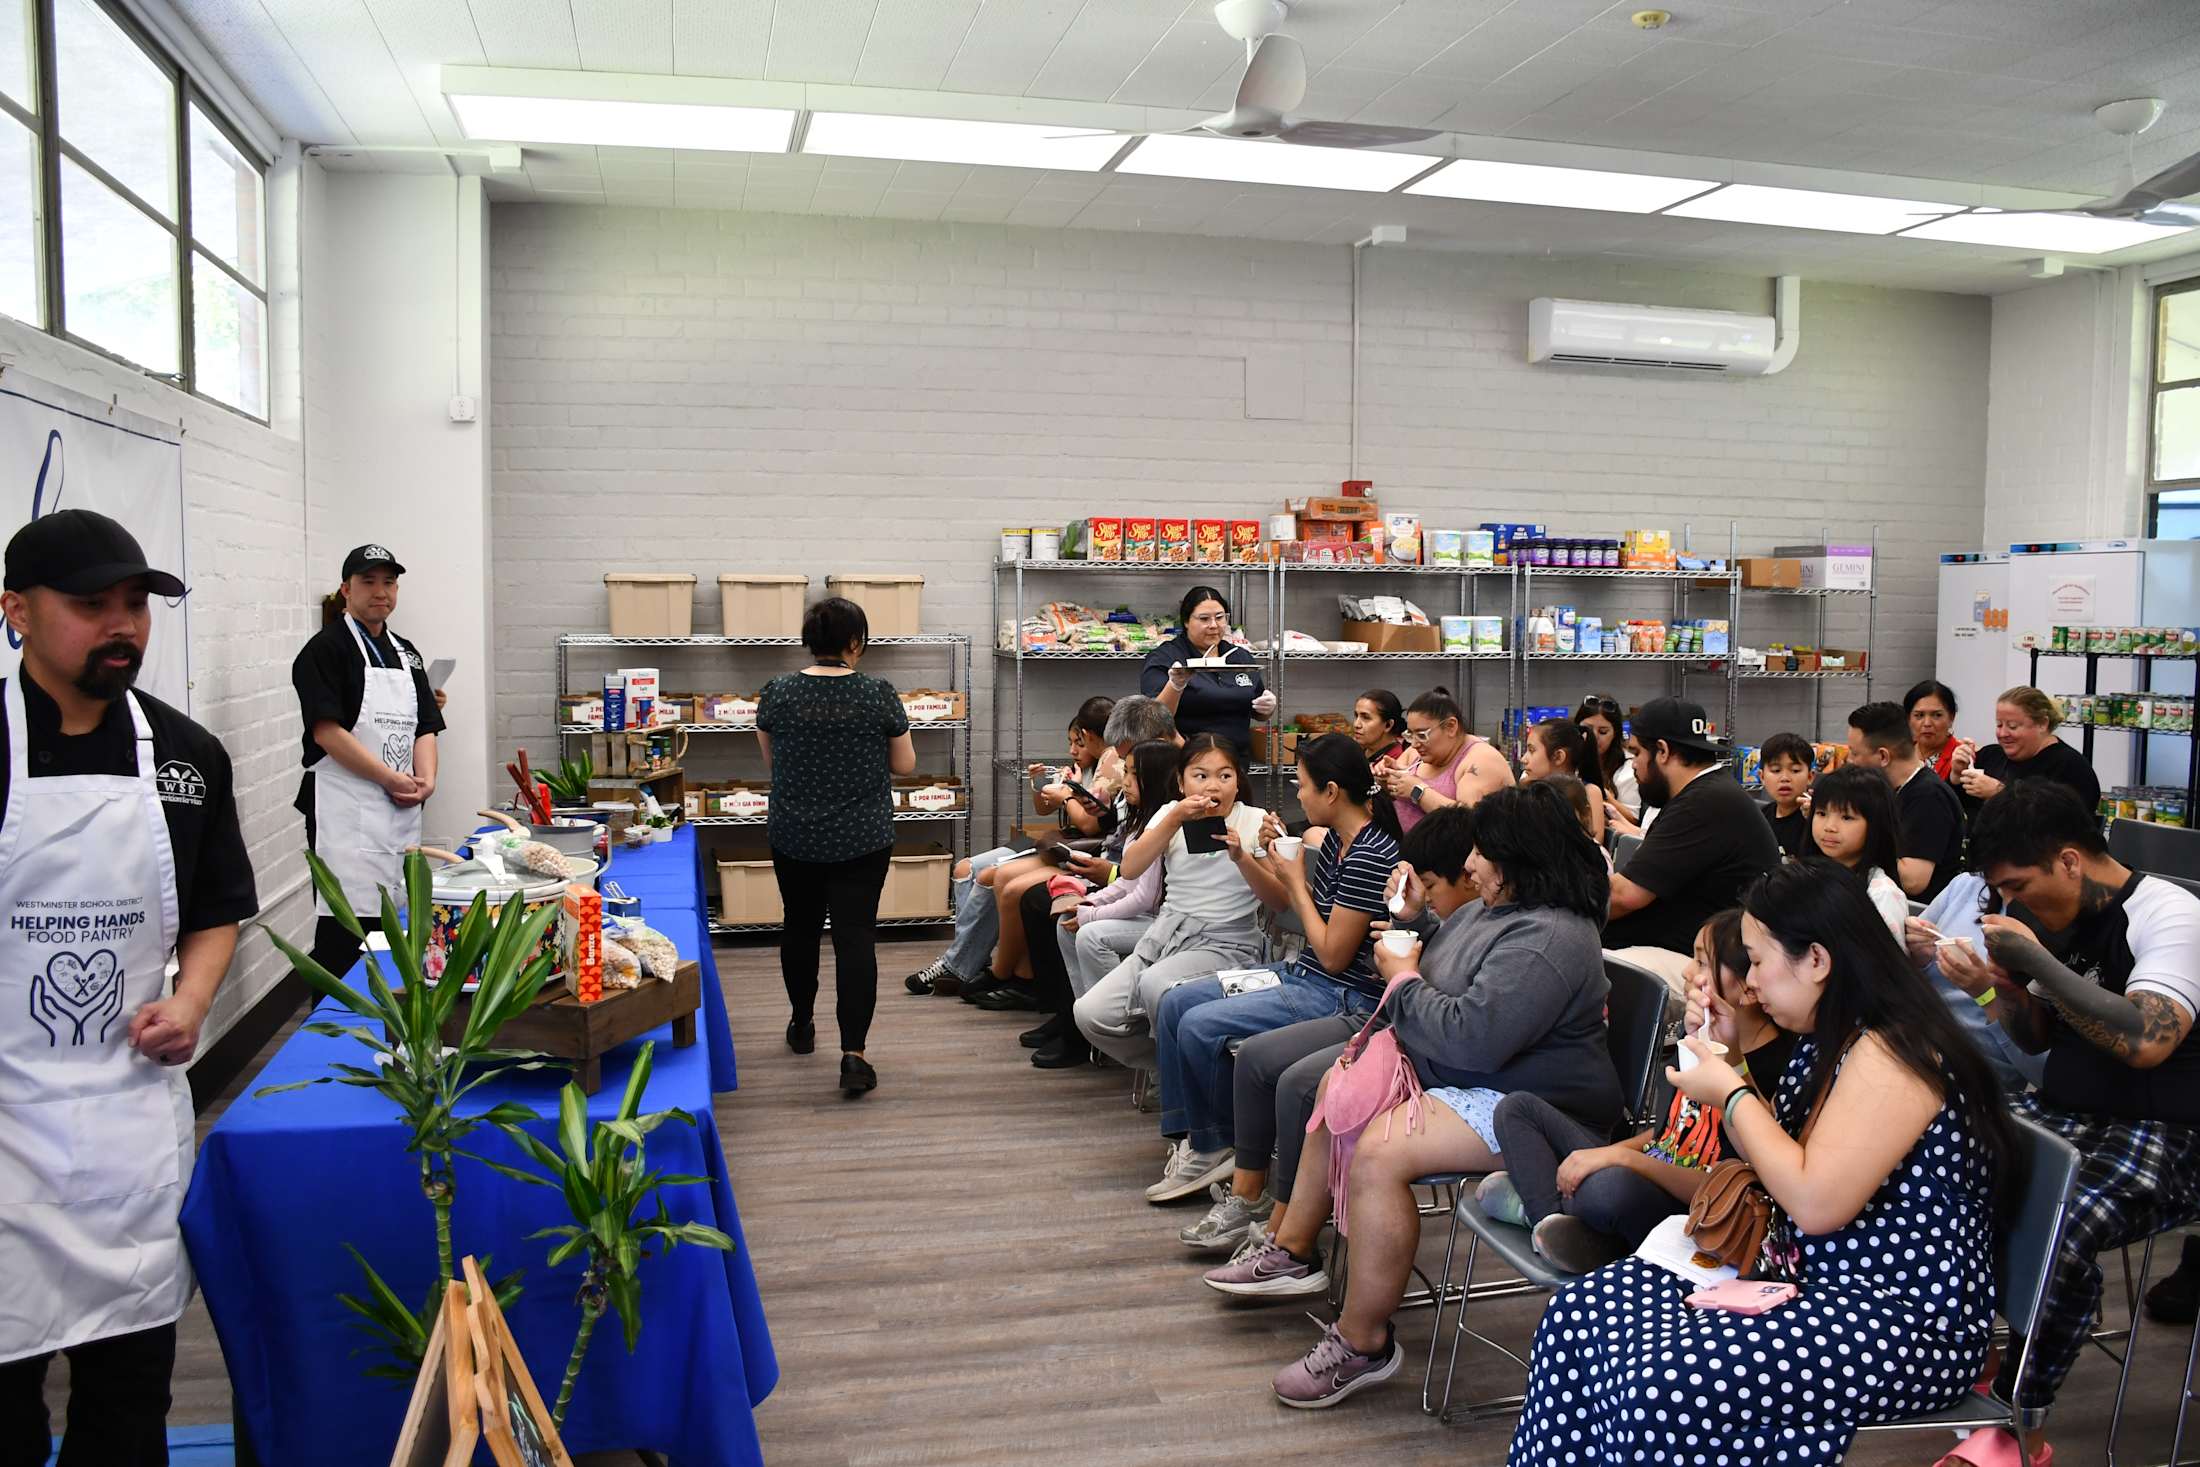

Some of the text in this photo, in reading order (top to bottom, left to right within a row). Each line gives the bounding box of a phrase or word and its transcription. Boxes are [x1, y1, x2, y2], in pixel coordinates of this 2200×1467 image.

[16, 896, 143, 909] WESTMINSTER SCHOOL DISTRICT
[11, 911, 145, 930] HELPING HANDS
[28, 926, 135, 943] FOOD PANTRY
[586, 933, 595, 965] Banza
